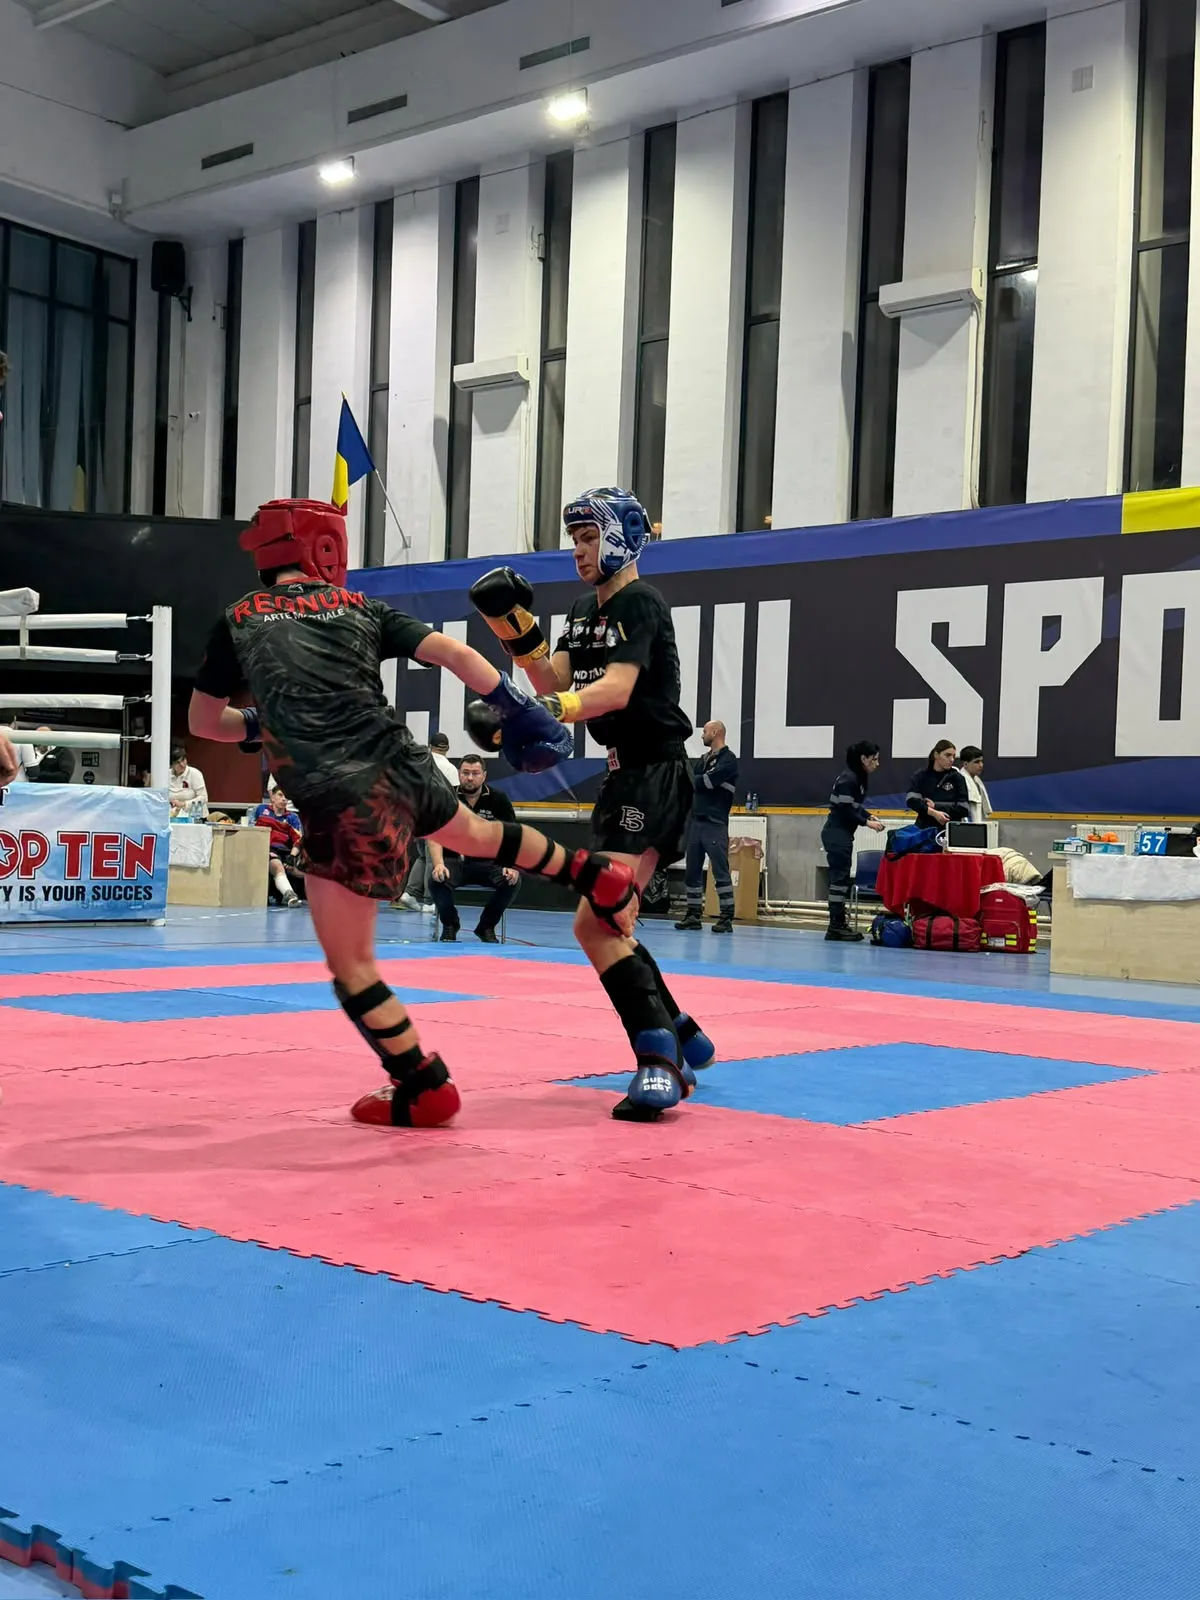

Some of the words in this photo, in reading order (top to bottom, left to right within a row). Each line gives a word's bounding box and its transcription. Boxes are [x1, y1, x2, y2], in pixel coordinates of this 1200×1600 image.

[233, 589, 365, 624] REGNUM
[263, 611, 293, 623] ARTE
[891, 569, 1200, 758] SPO
[57, 831, 157, 880] TEN
[1141, 835, 1165, 853] 57
[0, 885, 13, 902] Y
[19, 885, 36, 902] IS
[42, 885, 86, 902] YOUR
[91, 885, 153, 901] SUCCES
